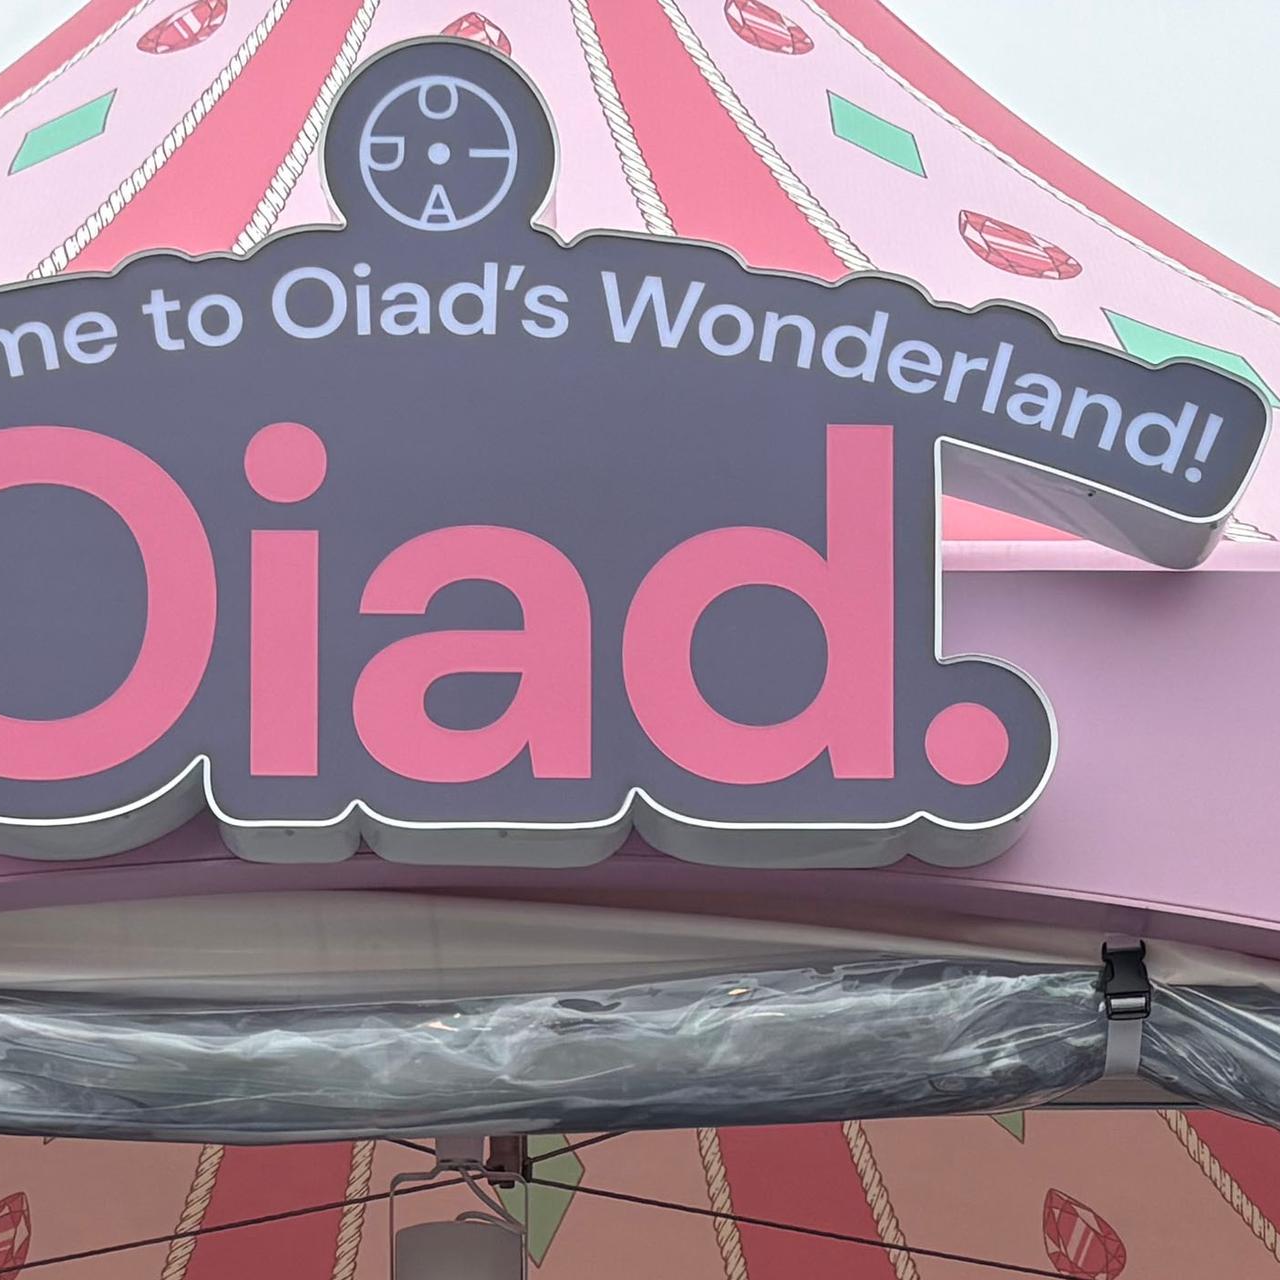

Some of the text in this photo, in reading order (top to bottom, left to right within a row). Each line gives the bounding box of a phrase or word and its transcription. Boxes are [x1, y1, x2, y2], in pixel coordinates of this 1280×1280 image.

[141, 278, 248, 353] to
[268, 262, 572, 342] Oiad’s
[600, 270, 1226, 484] Wonderland!
